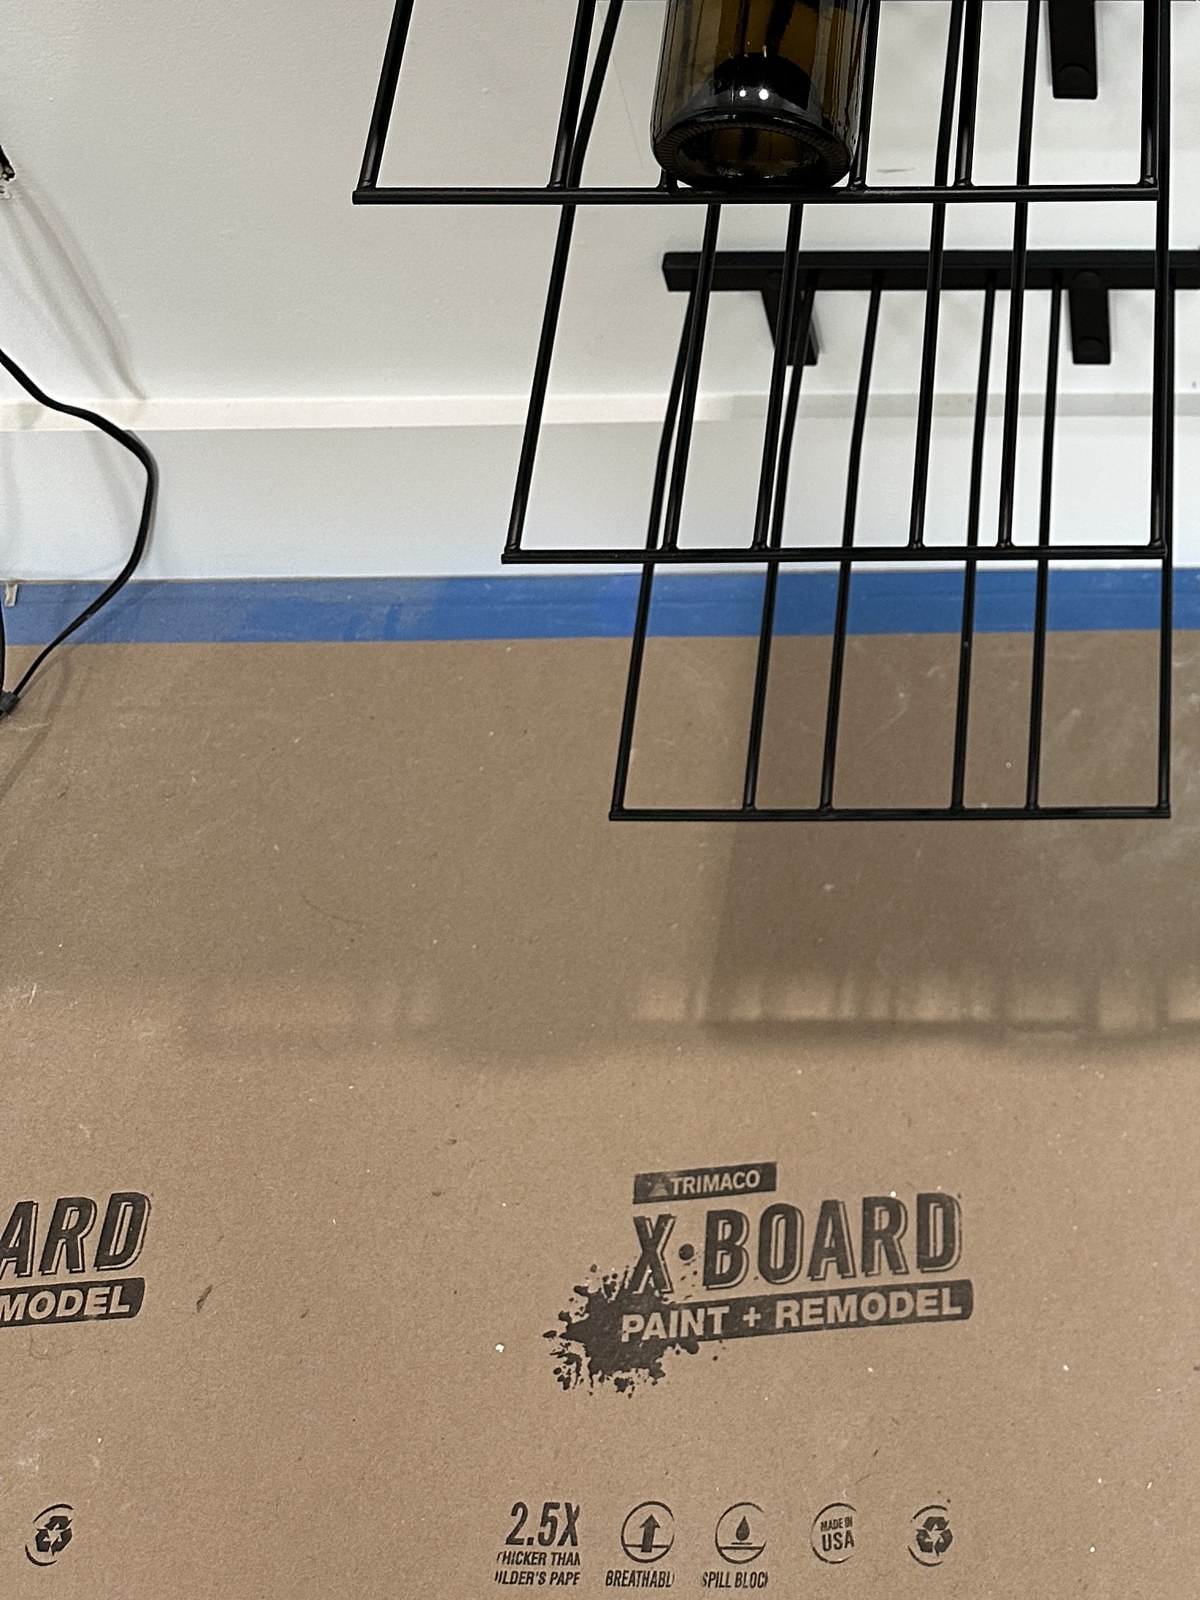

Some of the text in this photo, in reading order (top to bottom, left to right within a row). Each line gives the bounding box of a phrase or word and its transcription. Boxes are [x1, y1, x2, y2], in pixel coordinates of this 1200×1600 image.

[670, 1170, 761, 1195] TRIMACO
[621, 1306, 729, 1342] PAINT
[775, 1288, 962, 1328] REMODEL
[505, 1501, 580, 1546] 2.5X
[820, 1517, 844, 1532] MADE
[822, 1530, 855, 1552] USA
